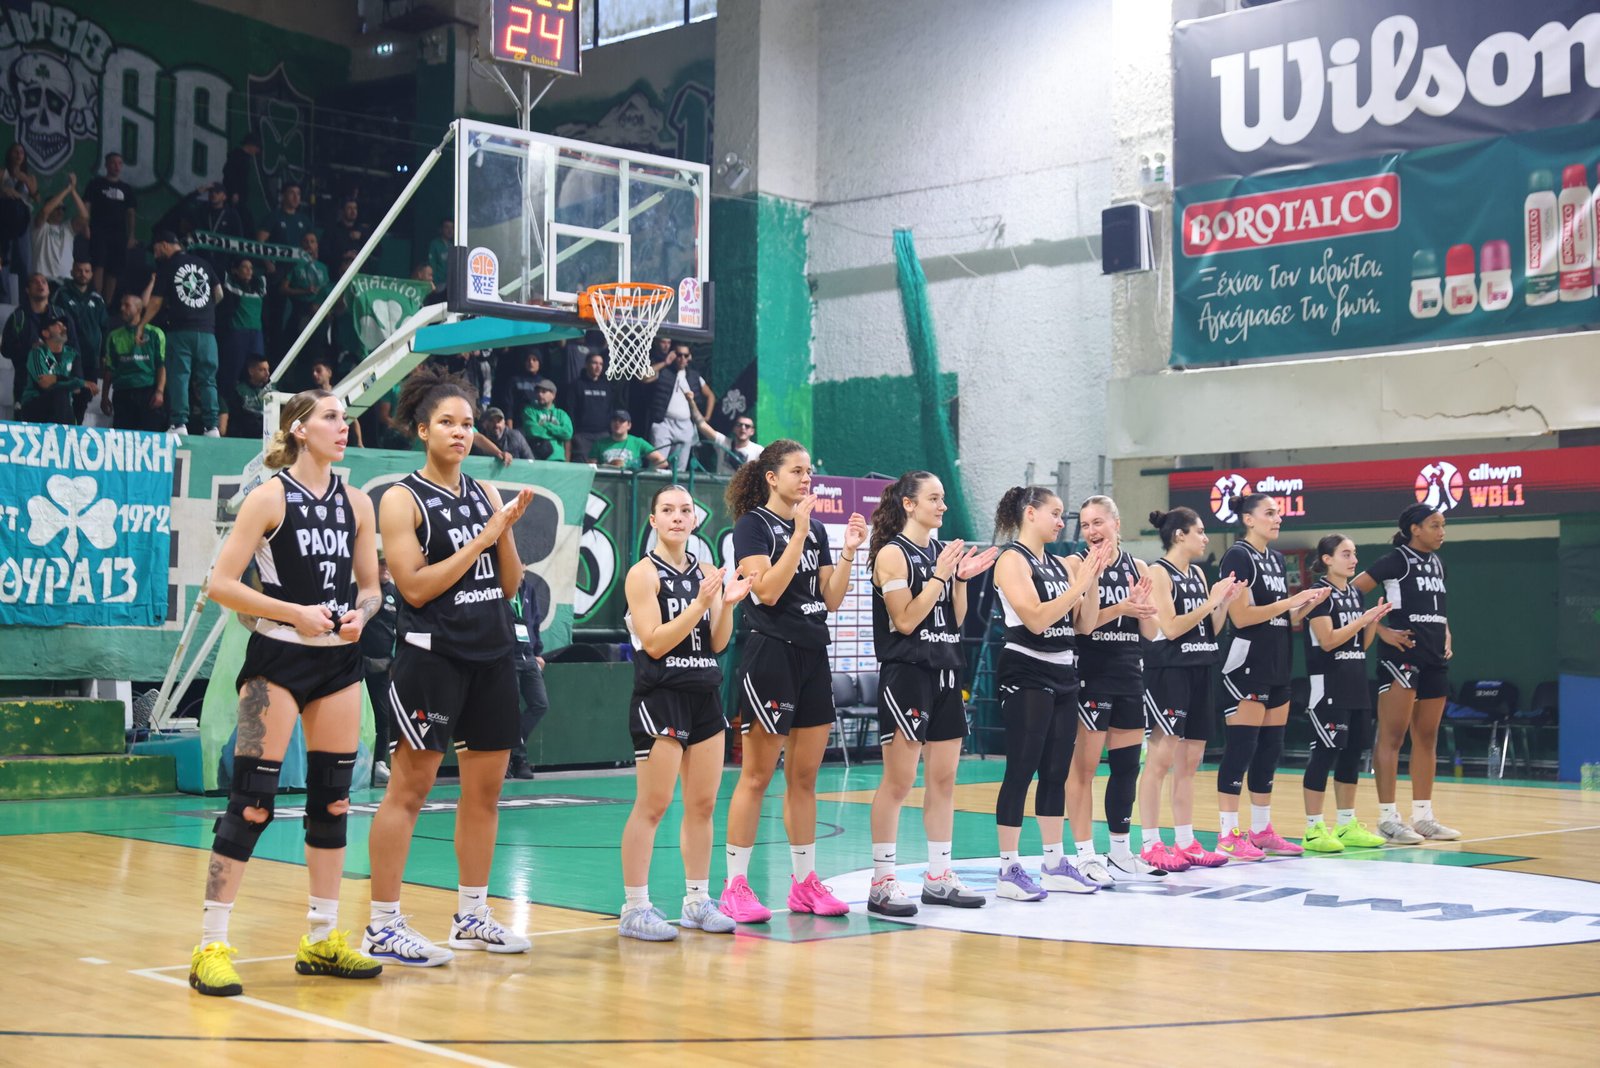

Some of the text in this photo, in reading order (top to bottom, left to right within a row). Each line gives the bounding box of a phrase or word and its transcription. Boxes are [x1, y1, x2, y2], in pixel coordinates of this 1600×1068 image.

[505, 5, 564, 60] 24
[1211, 14, 1600, 153] Wilson
[1189, 186, 1393, 247] BOROTALCO
[1197, 266, 1263, 300] Ξέχνα
[1309, 247, 1384, 299] ιδρώτα.
[1468, 463, 1522, 484] allwyn
[813, 483, 842, 499] allwyn
[1256, 476, 1304, 495] allwyn
[1469, 484, 1525, 508] WBL1
[814, 498, 844, 514] WBL1
[1274, 496, 1306, 517] BL1
[118, 504, 171, 535] 1972
[296, 528, 351, 558] PAOK
[448, 522, 497, 554] PAO
[474, 553, 495, 581] 20
[97, 556, 138, 604] 13
[1044, 581, 1072, 600] PAO
[1262, 574, 1288, 594] PAOK
[1416, 576, 1447, 594] PAOK
[934, 605, 946, 628] 10
[691, 628, 702, 651] 15
